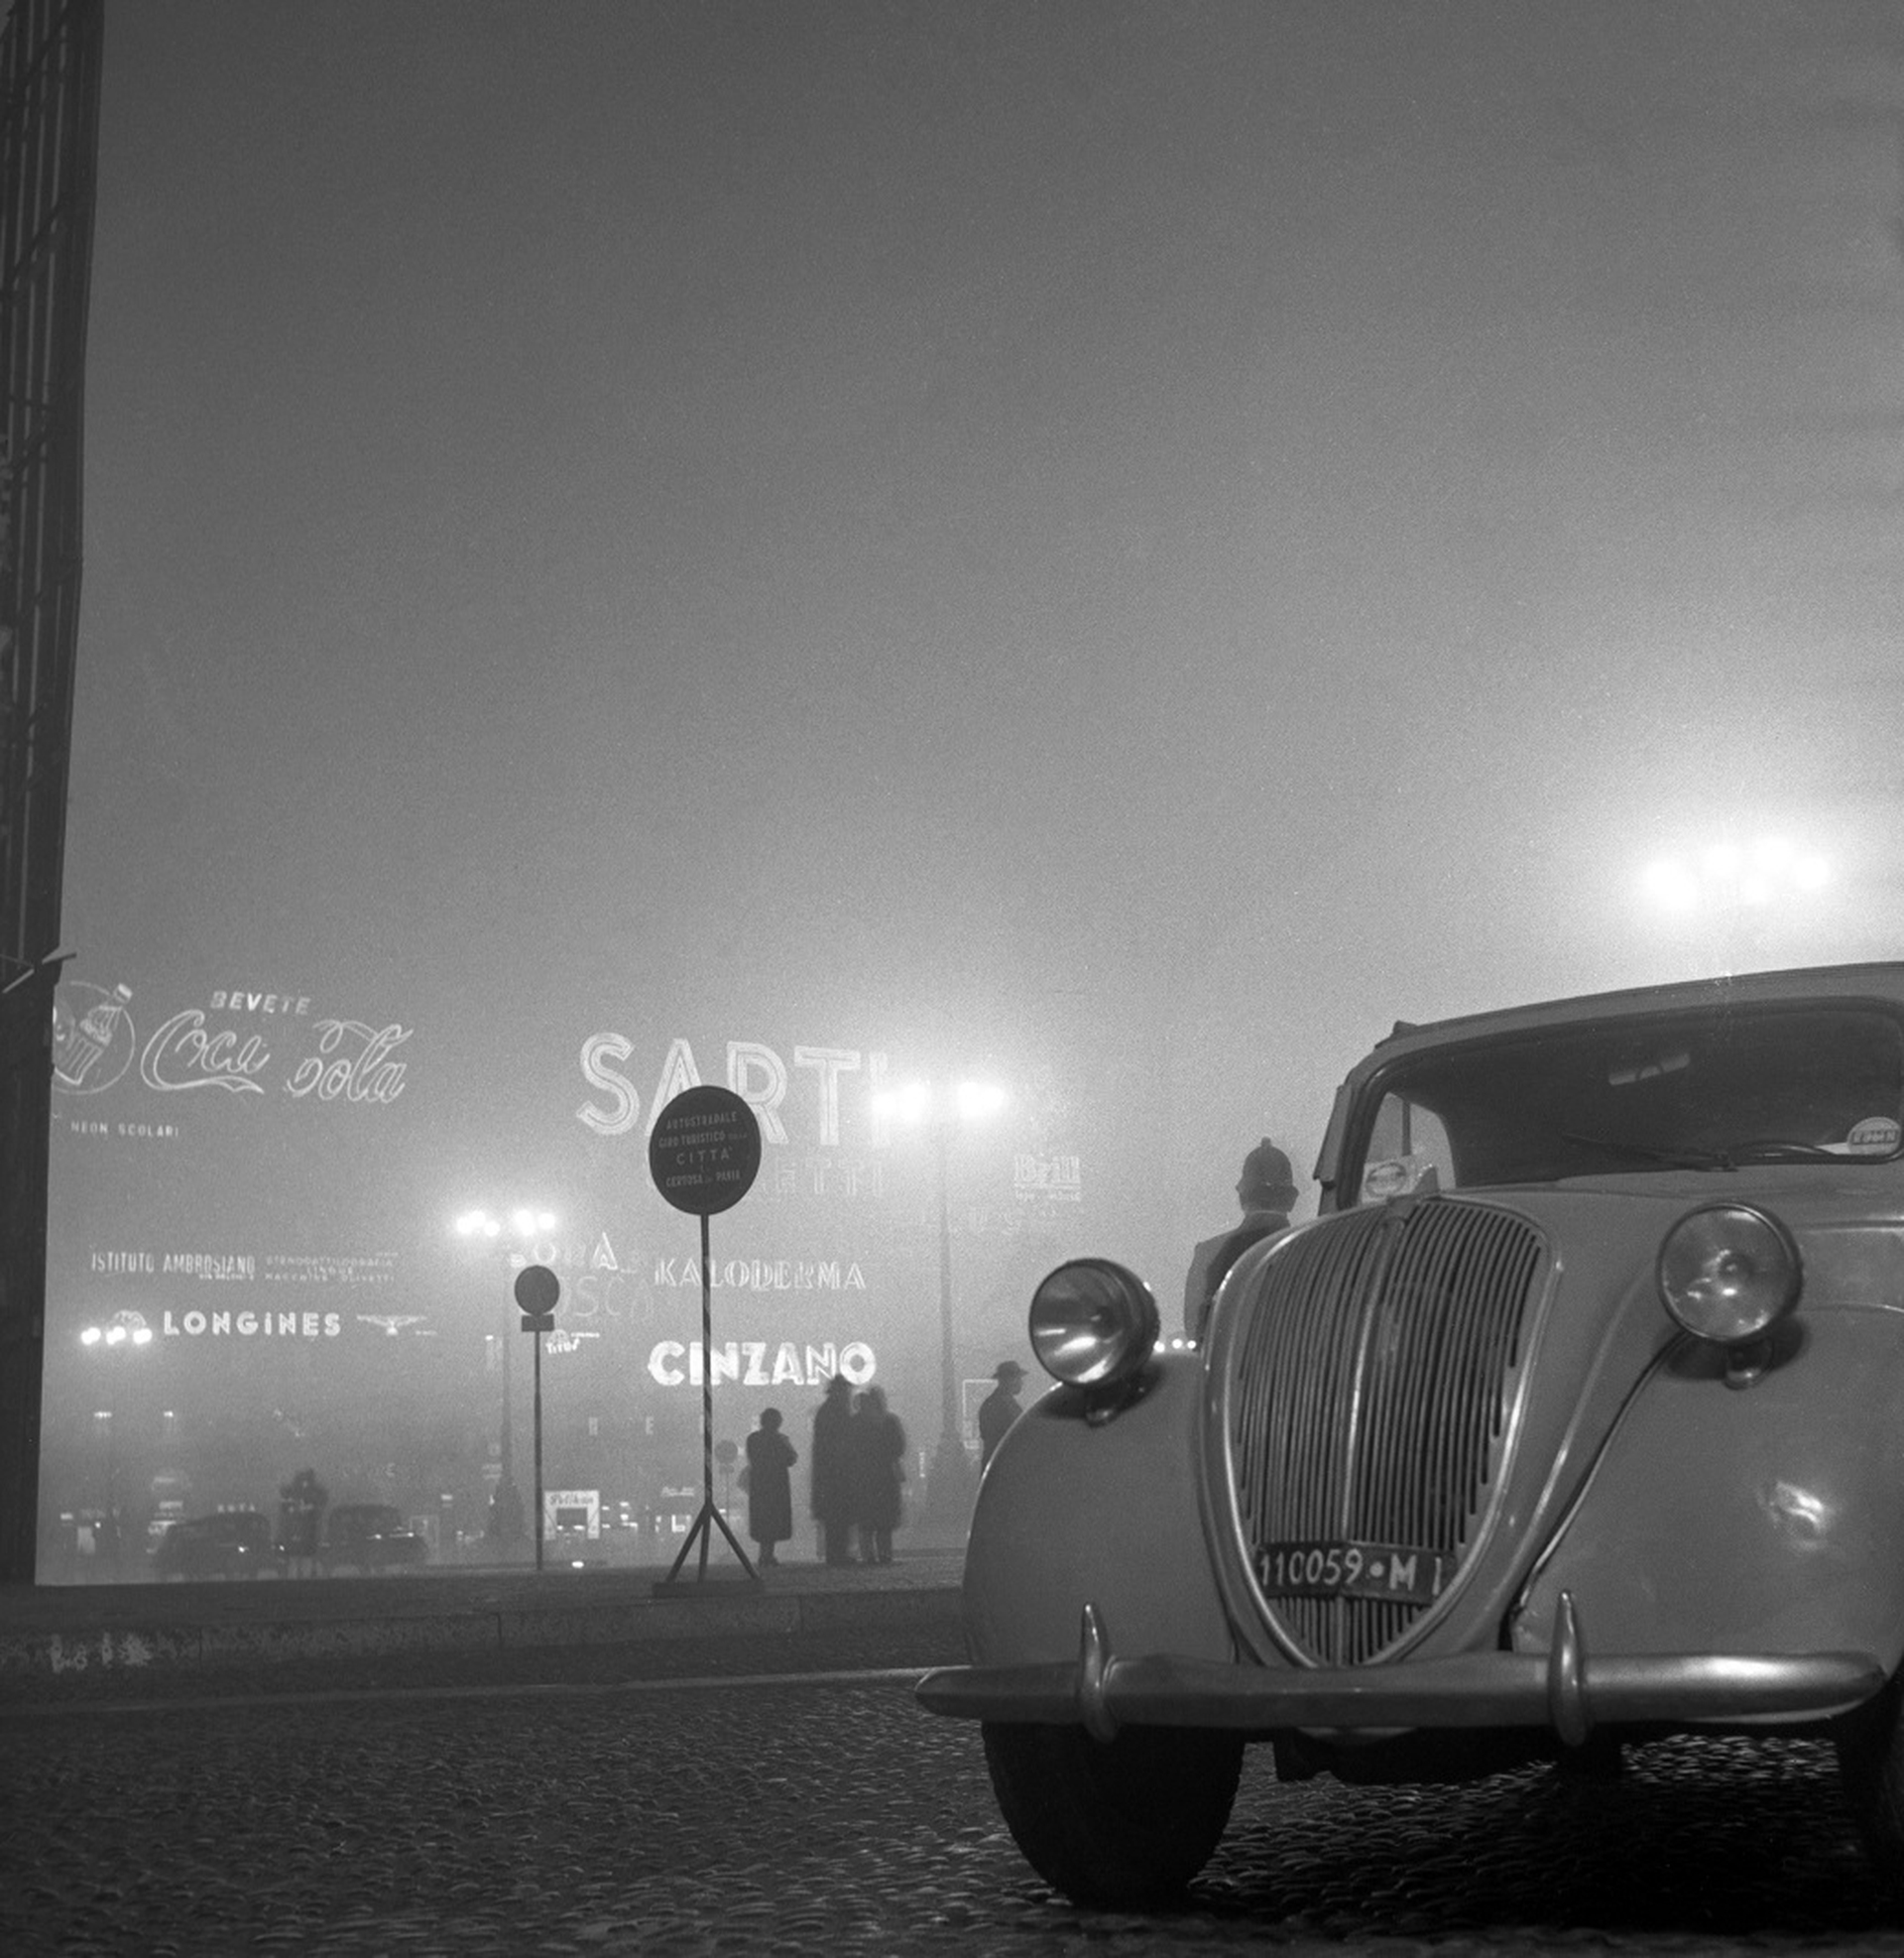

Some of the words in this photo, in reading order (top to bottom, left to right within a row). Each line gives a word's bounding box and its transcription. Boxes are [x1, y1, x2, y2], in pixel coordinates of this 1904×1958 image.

[210, 990, 311, 1016] BEVETE
[140, 1009, 271, 1094] Coca
[287, 1019, 415, 1103] Cola
[70, 1120, 109, 1135] NEON
[117, 1122, 179, 1138] SCOLARI
[666, 1111, 737, 1130] AUTOSTRADALE
[658, 1136, 679, 1149] GIRO
[680, 1130, 726, 1146] TURISTICO
[91, 1251, 155, 1274] ISTITUTO
[163, 1253, 256, 1276] AMBROSIANO
[654, 1258, 867, 1290] KALODERMA
[648, 1340, 877, 1386] CINZANO
[1260, 1548, 1364, 1587] 110059
